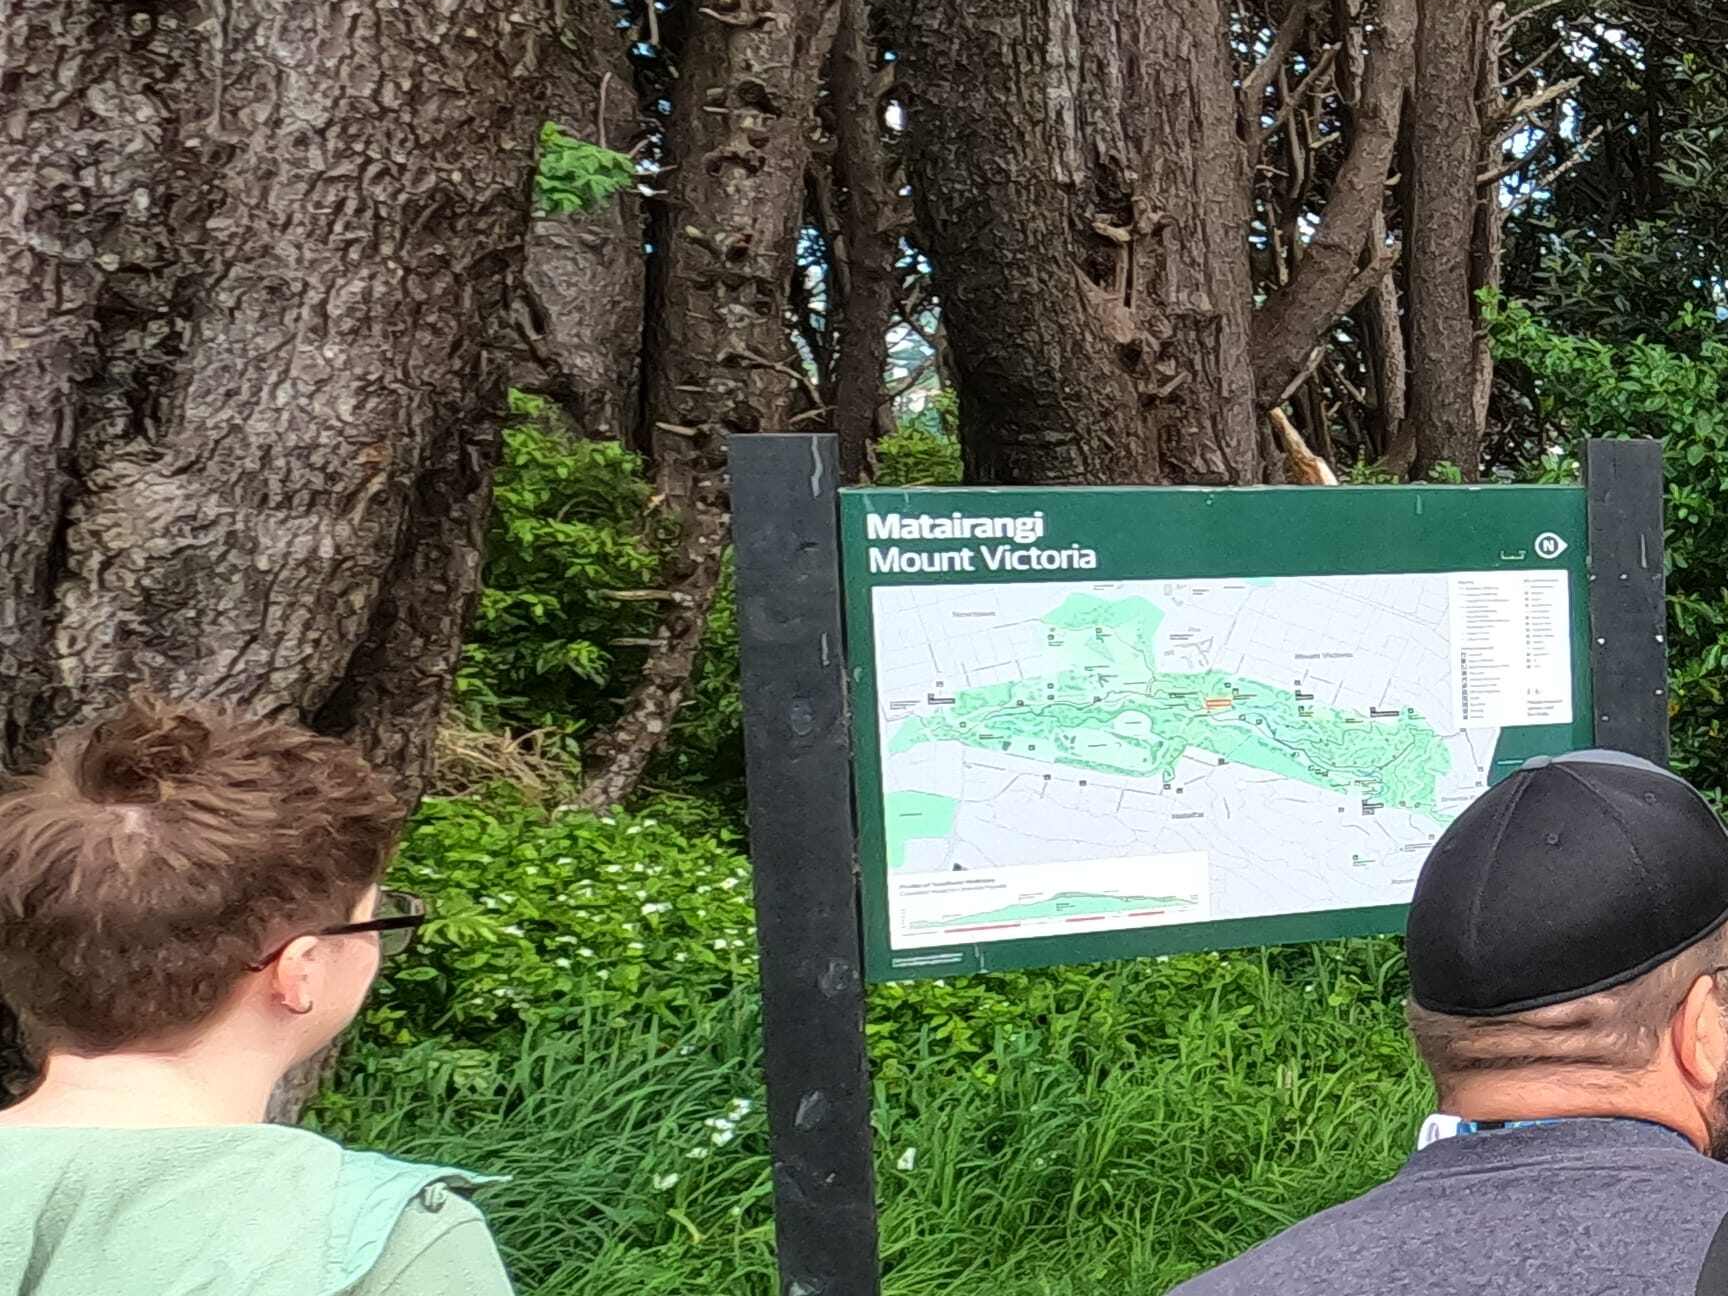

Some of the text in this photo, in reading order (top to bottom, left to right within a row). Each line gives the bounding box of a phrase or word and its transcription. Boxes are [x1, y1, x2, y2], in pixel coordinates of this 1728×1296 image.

[866, 511, 1044, 543] Matairangi
[868, 543, 1097, 573] Mount Victoria
